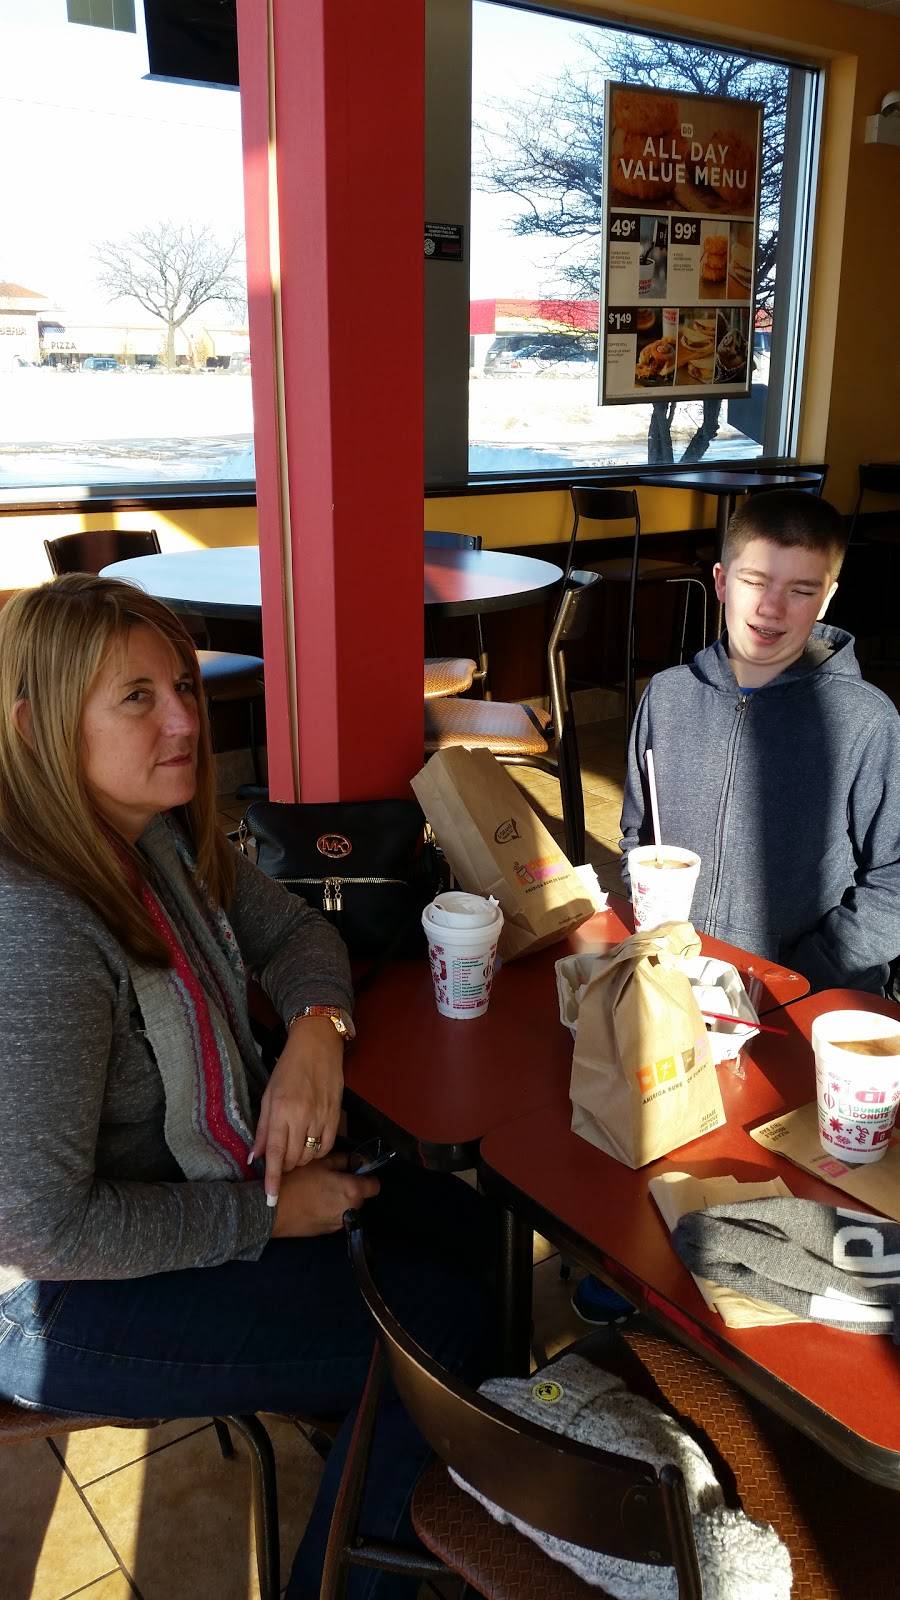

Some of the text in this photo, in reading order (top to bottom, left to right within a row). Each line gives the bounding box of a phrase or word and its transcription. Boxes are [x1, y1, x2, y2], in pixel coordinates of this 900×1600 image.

[643, 136, 730, 164] ALL DAY
[619, 158, 748, 190] VALUE MENU
[610, 219, 636, 237] 49¢
[674, 222, 697, 240] 99¢
[51, 341, 77, 350] PIZZA
[322, 838, 349, 853] MK
[853, 1111, 890, 1120] DONUTS
